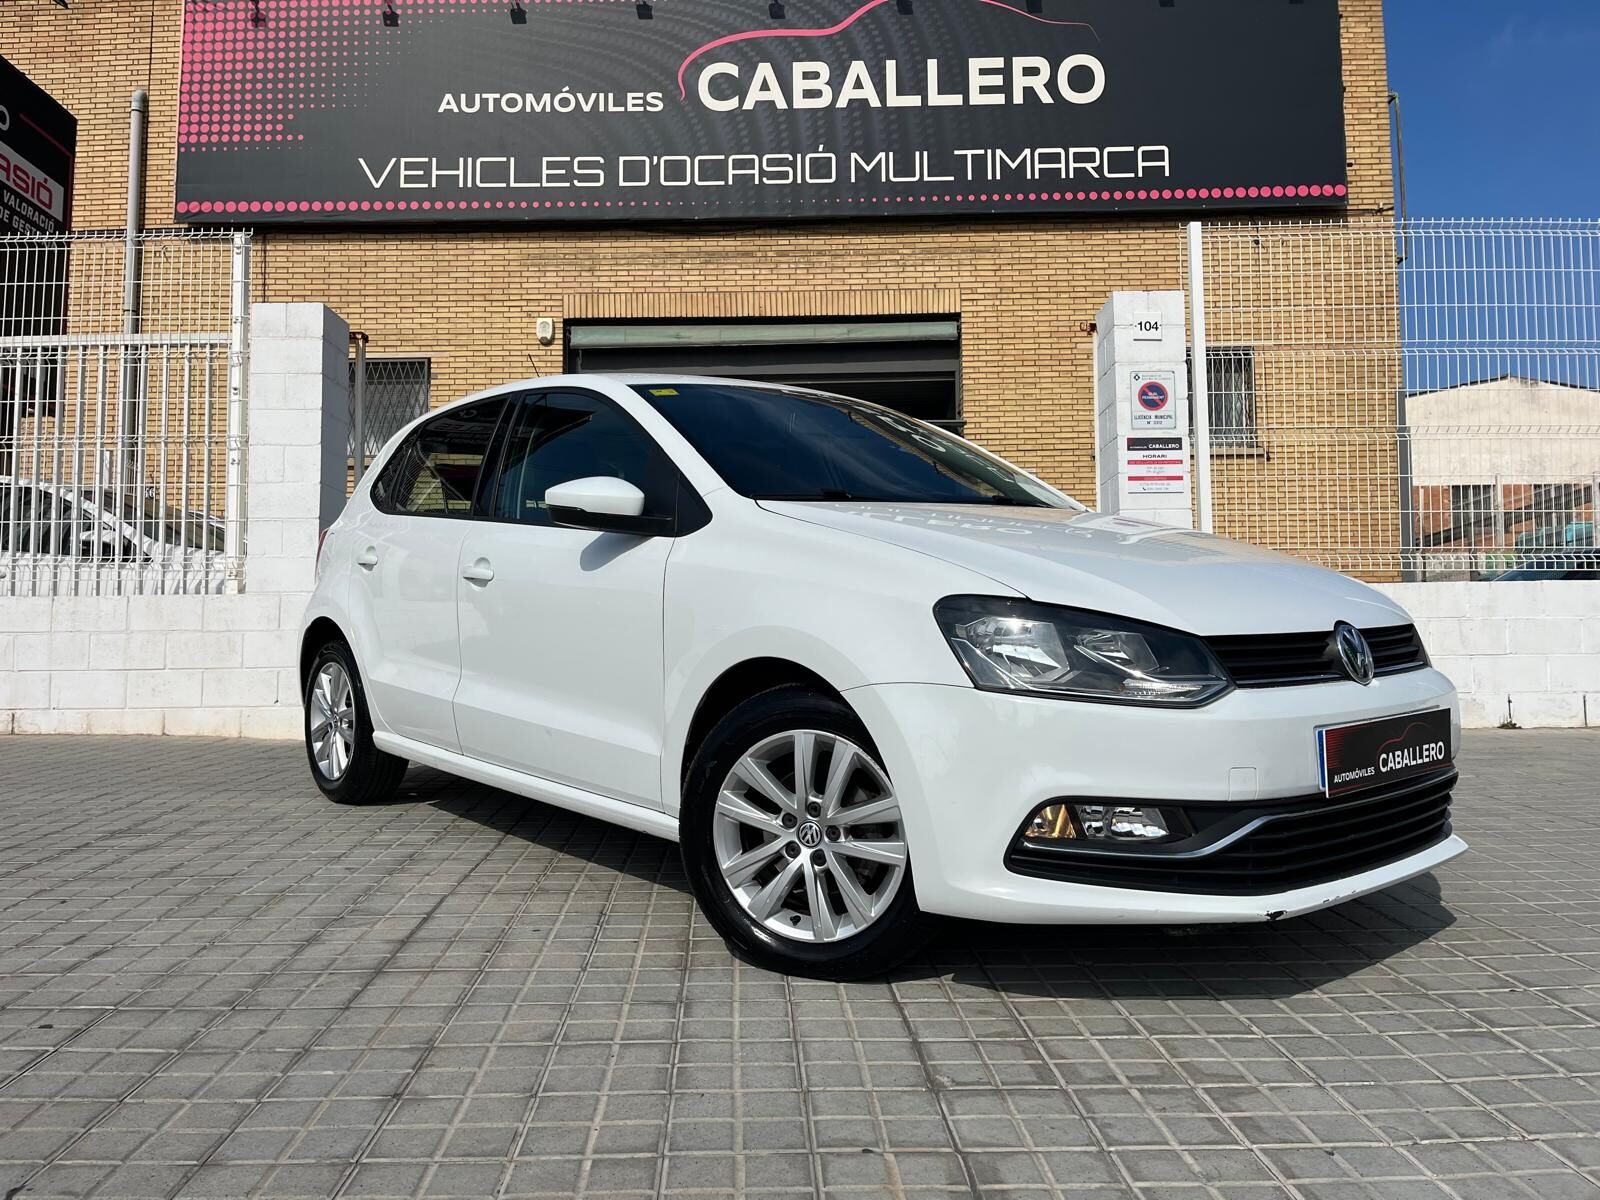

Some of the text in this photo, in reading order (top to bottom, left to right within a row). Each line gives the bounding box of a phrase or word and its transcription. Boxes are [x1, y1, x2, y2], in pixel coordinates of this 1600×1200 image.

[437, 53, 1106, 113] AUTOMÓVILES CABALLERO
[357, 155, 605, 189] VEHICLES
[850, 145, 1171, 184] MULTIMARCA
[1137, 320, 1160, 331] 104
[1333, 741, 1445, 784] AUTOMÓVILES CABALLERO
